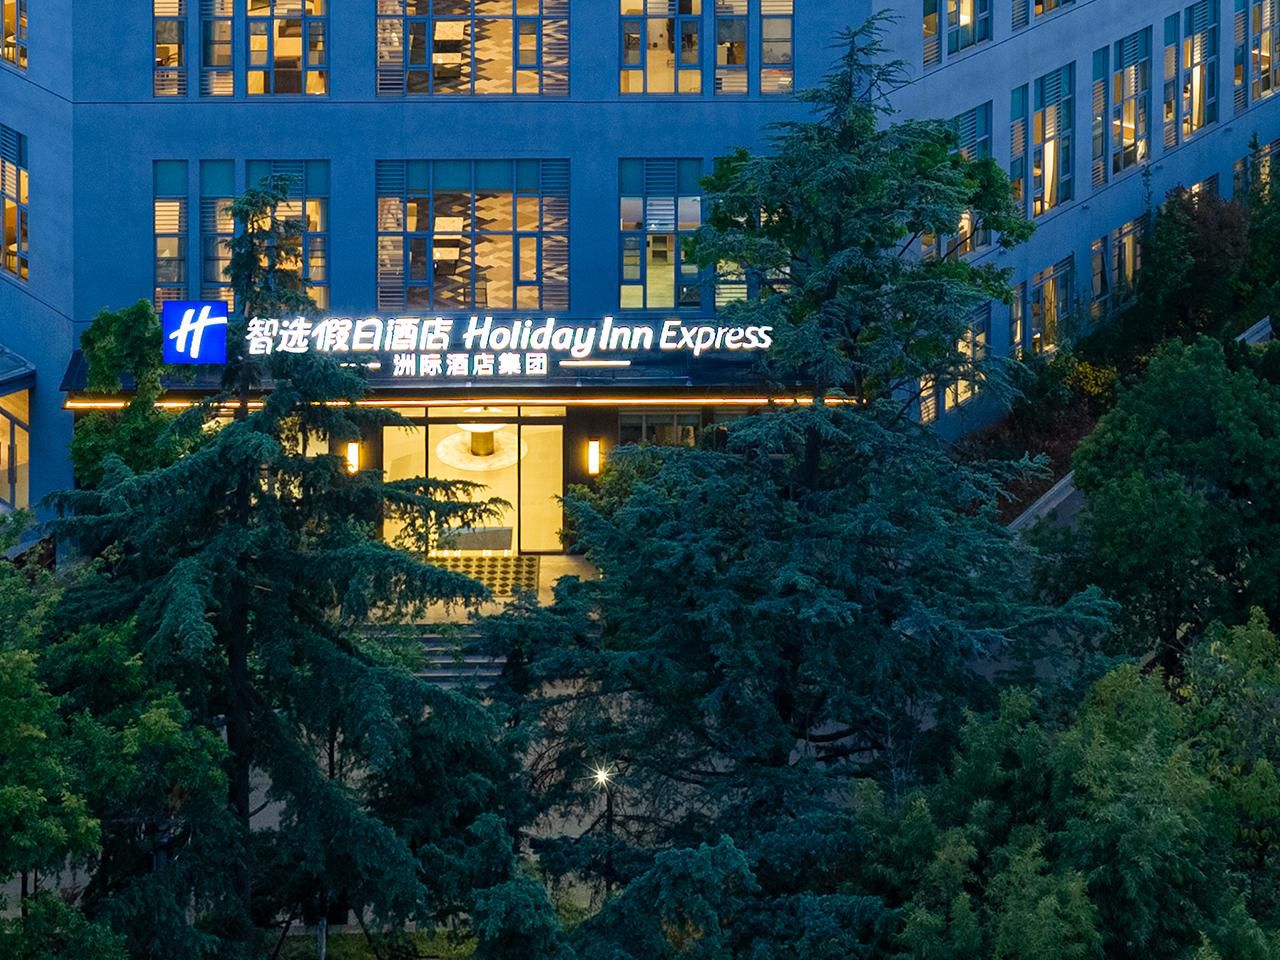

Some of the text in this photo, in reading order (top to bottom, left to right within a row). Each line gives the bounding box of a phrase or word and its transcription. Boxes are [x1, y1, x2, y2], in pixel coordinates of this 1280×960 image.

[245, 316, 453, 355] 智选假日酒店
[462, 316, 774, 358] Holiday Inn Express
[392, 353, 548, 376] 洲际酒店集团
